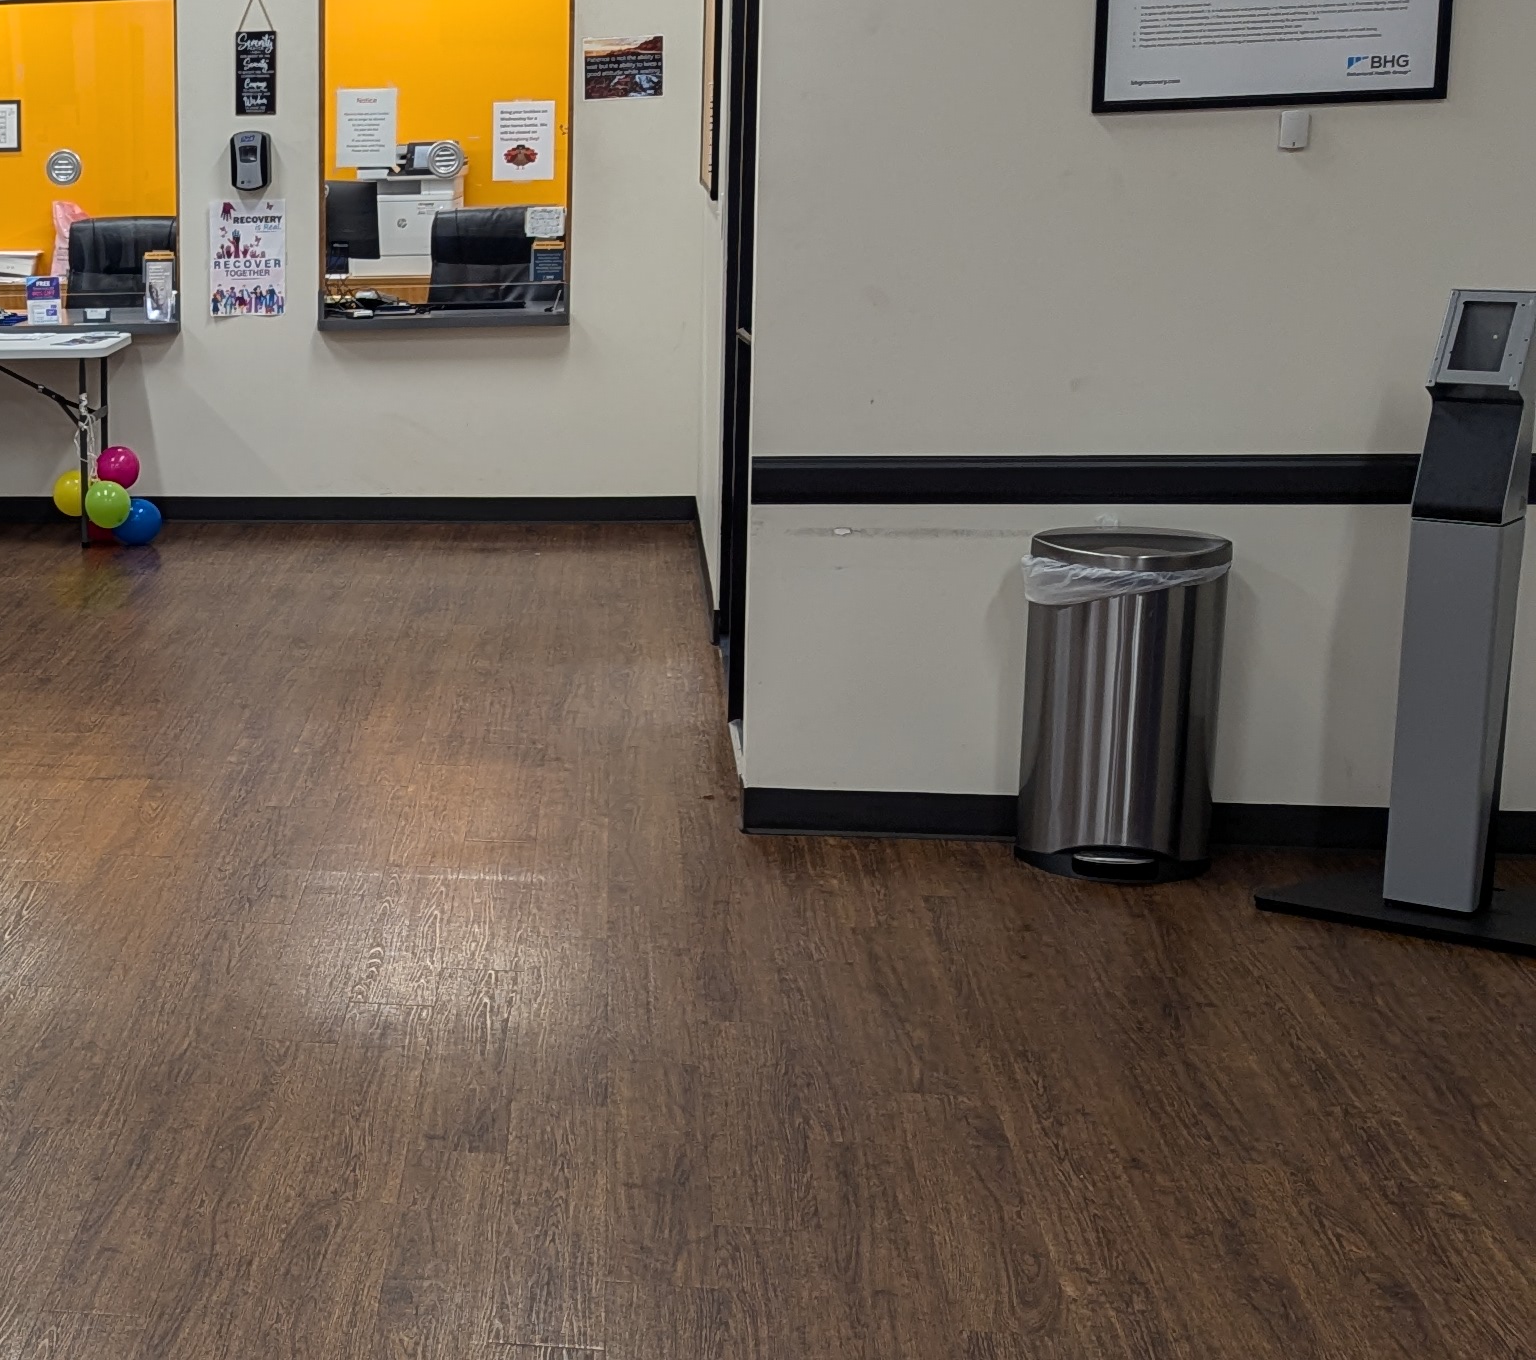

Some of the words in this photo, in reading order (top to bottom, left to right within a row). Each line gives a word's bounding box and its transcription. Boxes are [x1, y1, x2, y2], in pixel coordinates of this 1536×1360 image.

[1370, 54, 1410, 69] BHG
[233, 215, 283, 224] RECOVERY
[214, 259, 281, 269] RECOVER
[225, 269, 270, 277] TOGETHER
